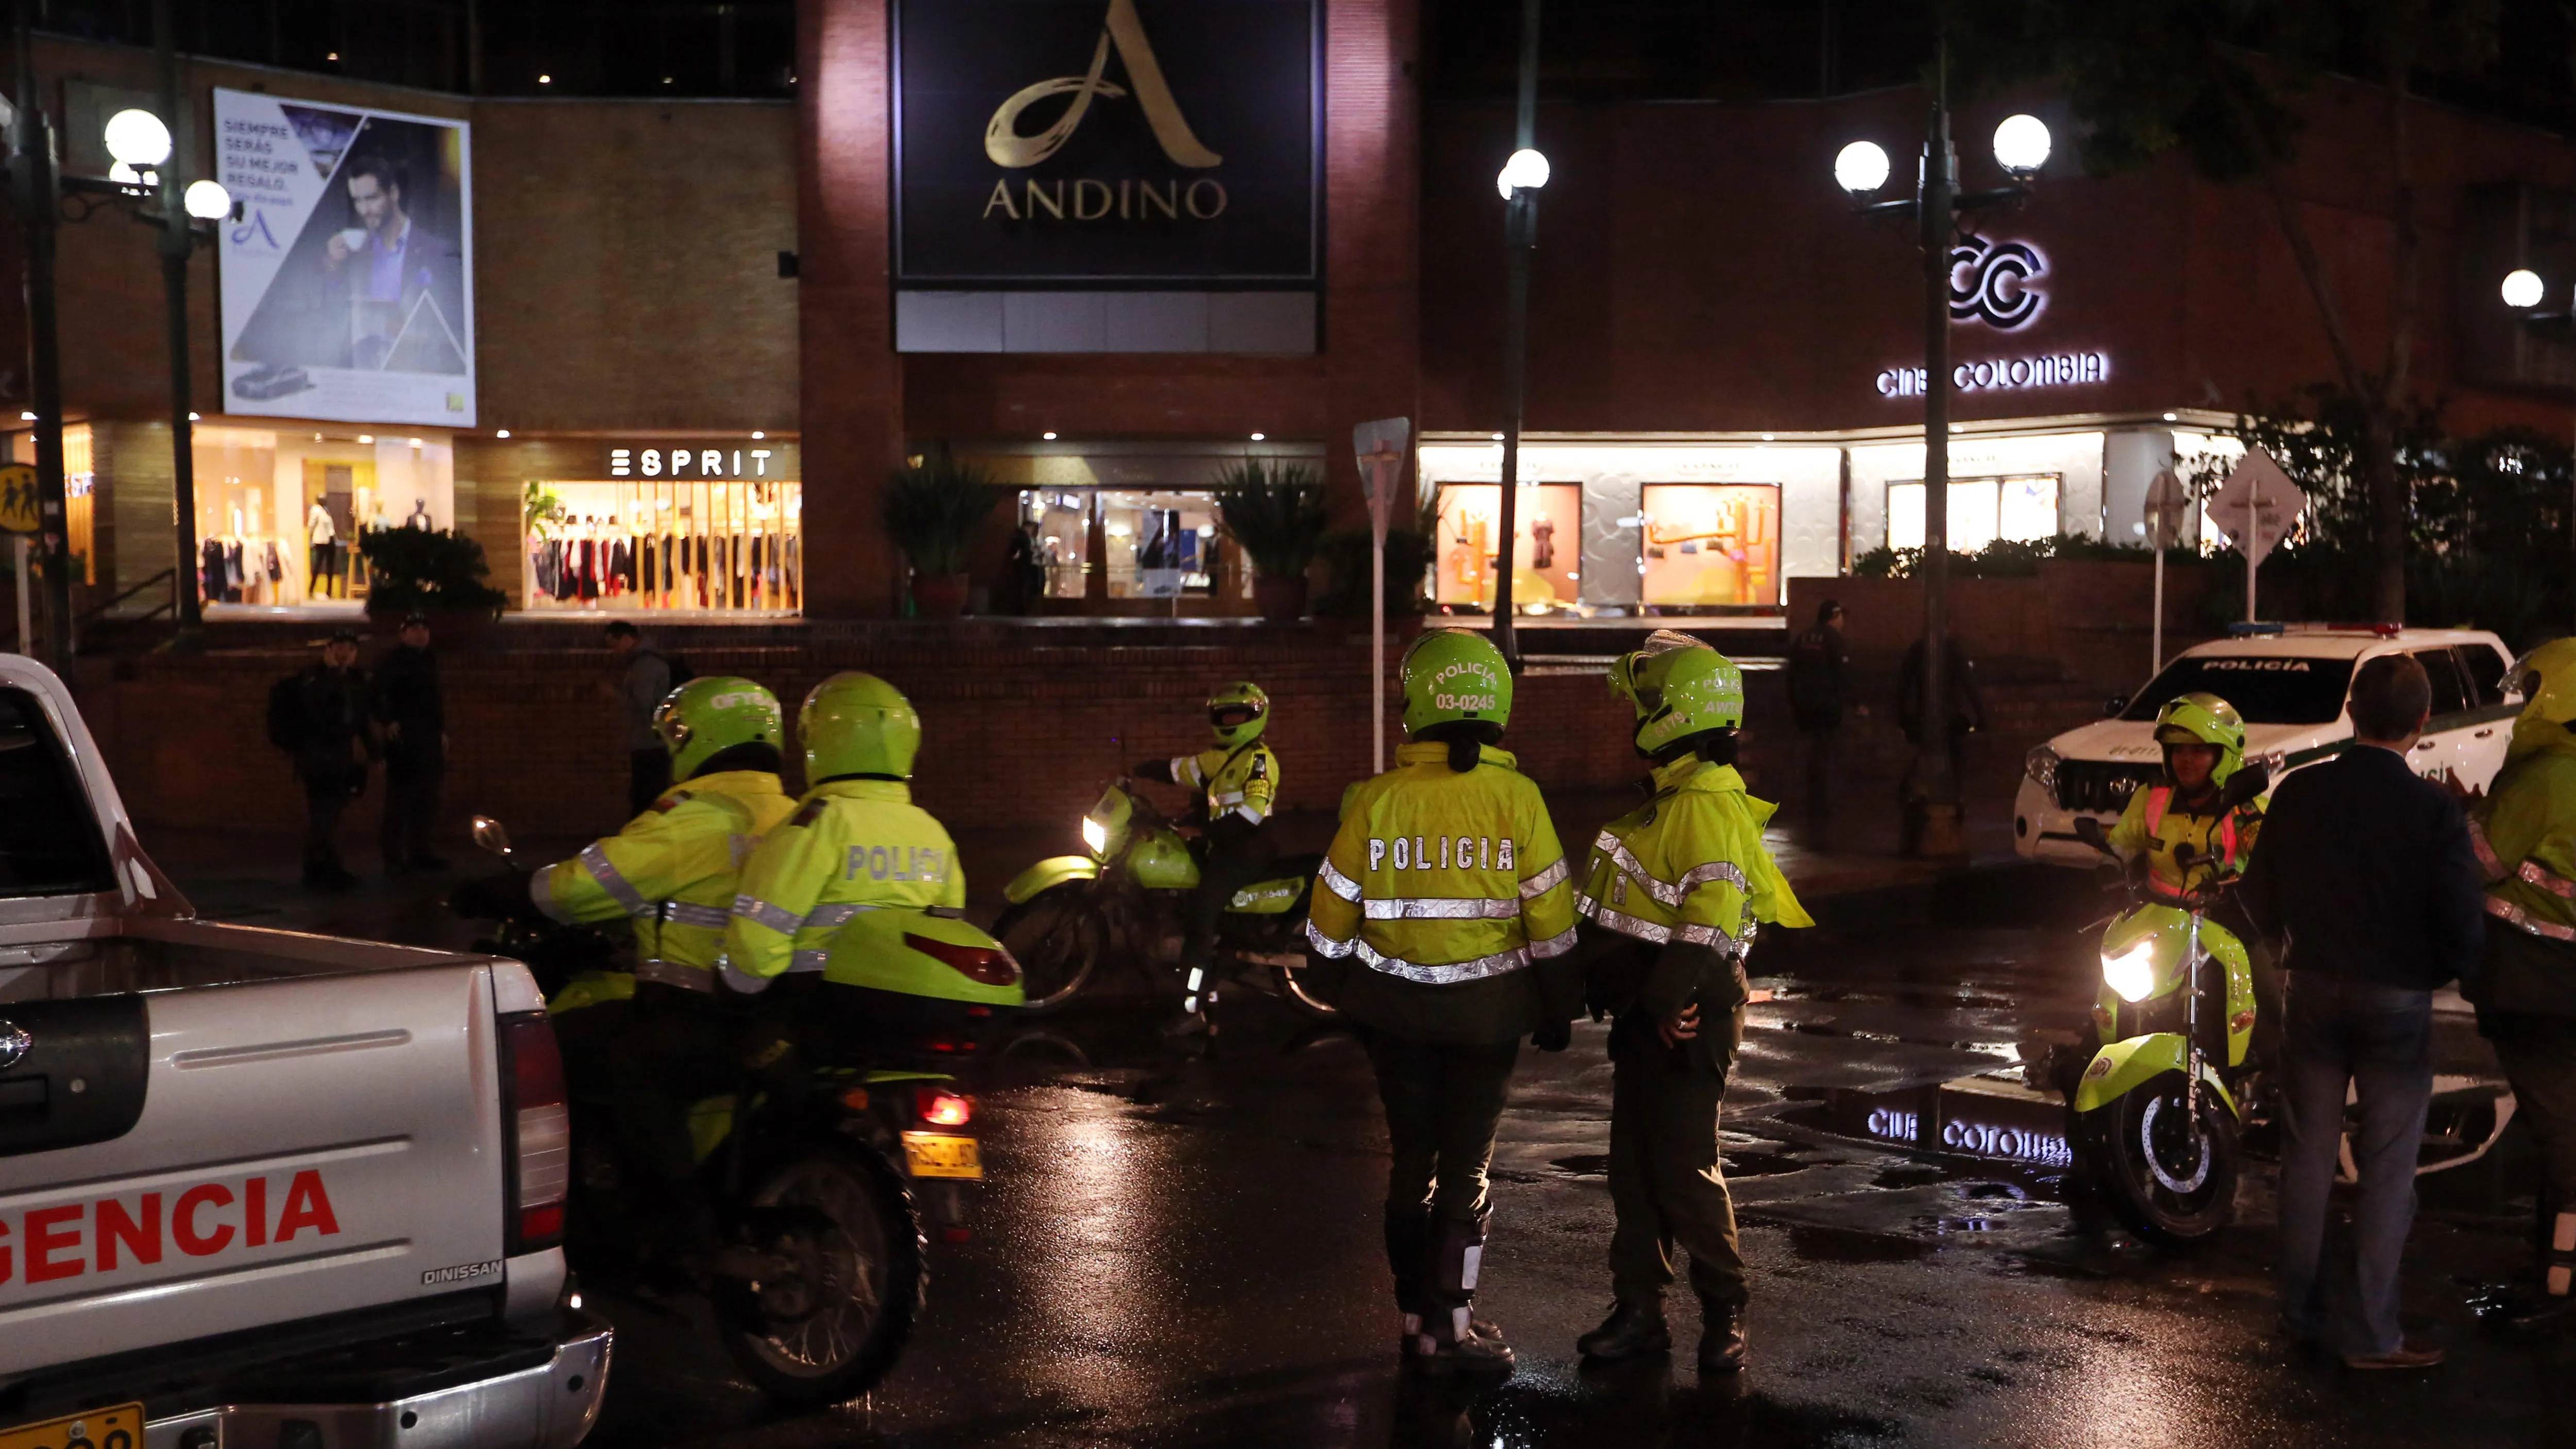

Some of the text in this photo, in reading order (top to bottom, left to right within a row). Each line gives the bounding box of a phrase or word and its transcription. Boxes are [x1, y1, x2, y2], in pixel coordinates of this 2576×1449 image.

[983, 178, 1228, 220] ANDINO
[1953, 352, 2108, 392] COLOMBIA
[610, 449, 772, 477] ESPRIT
[1435, 661, 1498, 686] POLICIA
[1435, 693, 1496, 710] 03-0245
[1368, 834, 1515, 873] POLICIA
[0, 1168, 341, 1287] ENCIA
[421, 1259, 503, 1285] DINISSAN
